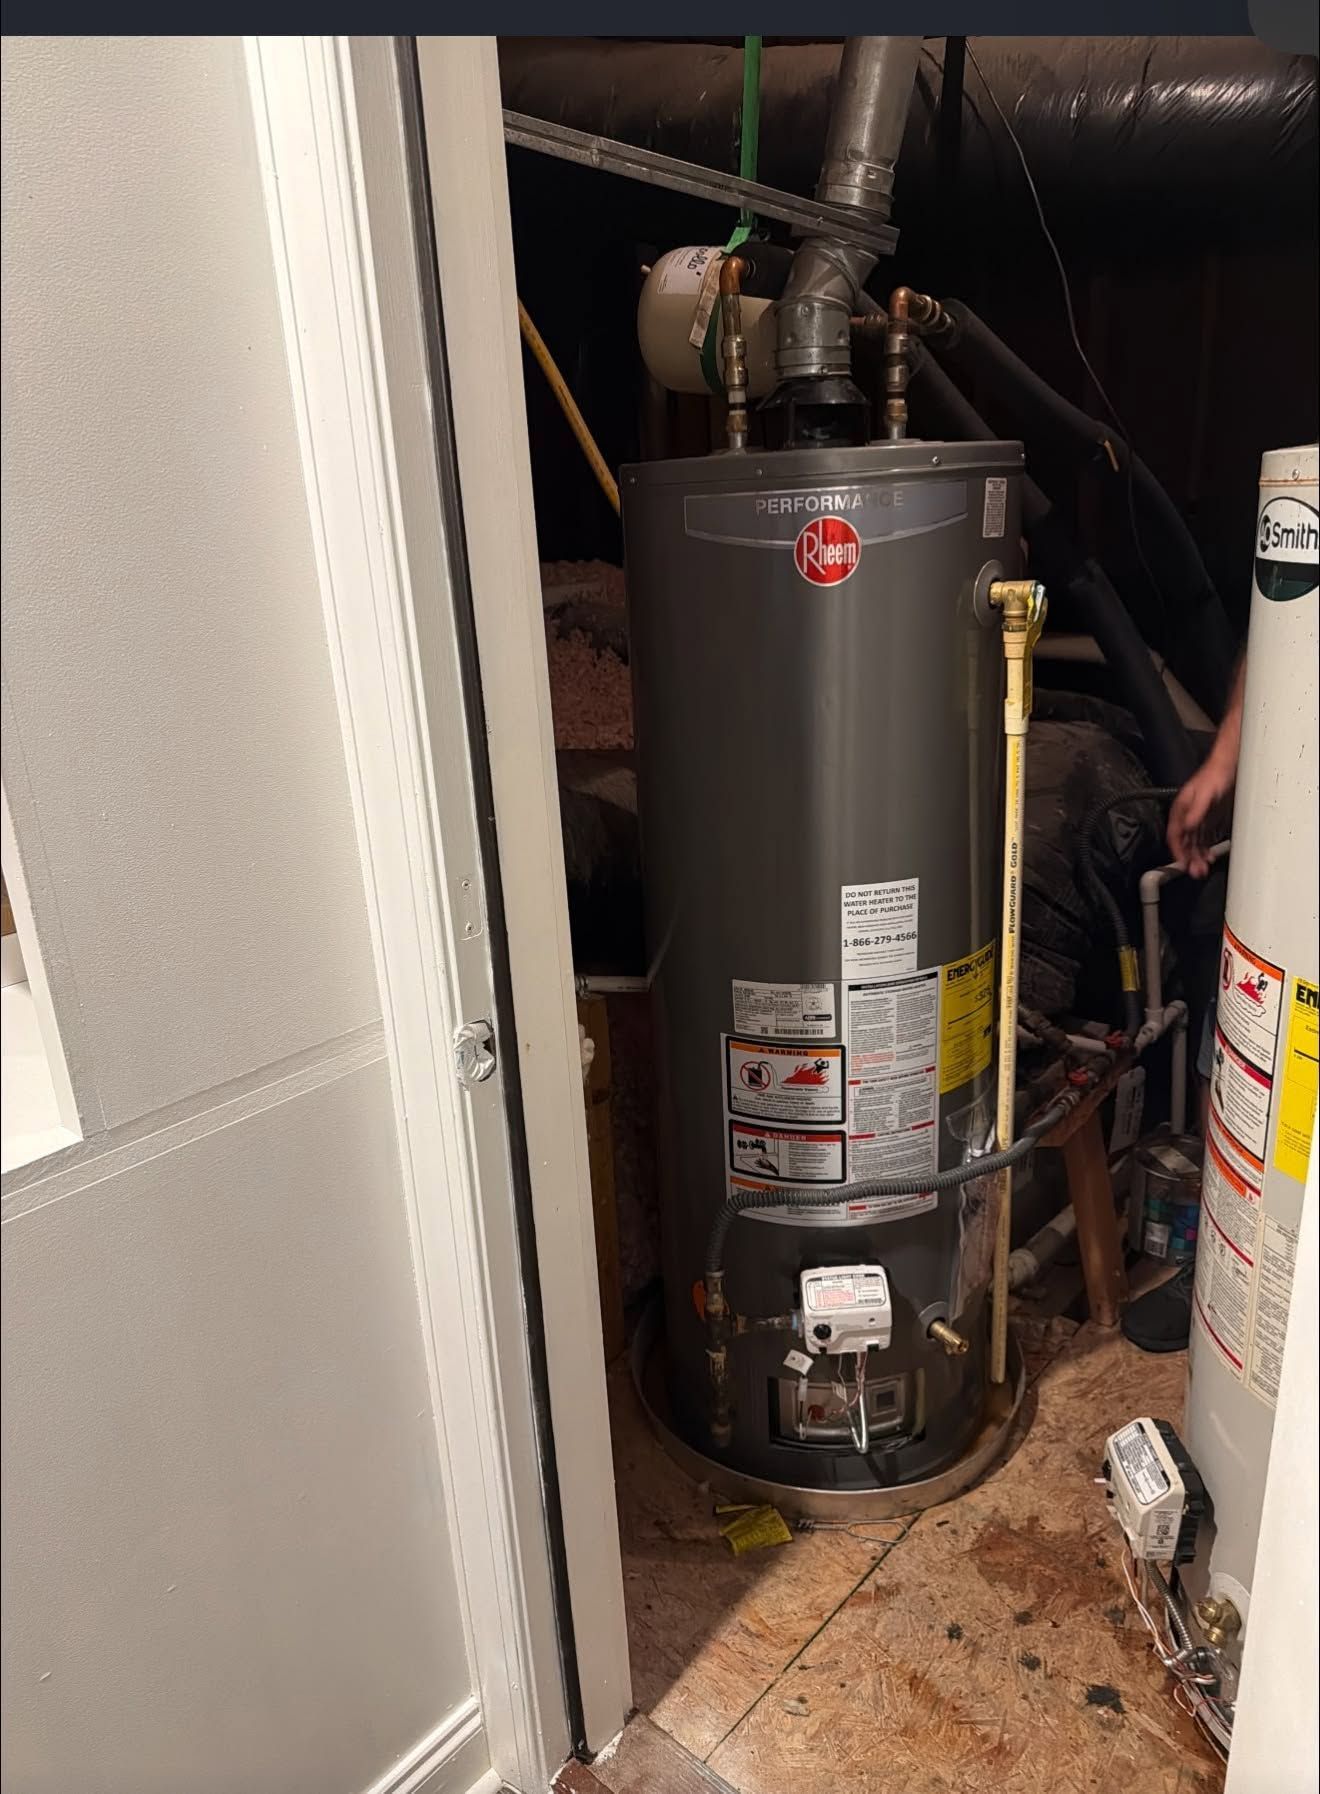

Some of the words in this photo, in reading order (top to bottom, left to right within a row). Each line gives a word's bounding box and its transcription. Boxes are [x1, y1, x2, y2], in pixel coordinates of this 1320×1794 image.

[755, 491, 904, 515] PERFORMACE
[803, 520, 857, 575] Rheem
[1271, 521, 1319, 550] Smith
[1010, 842, 1018, 869] GOLD
[858, 890, 873, 898] NOT
[874, 887, 900, 896] RETURN
[868, 897, 894, 906] HEATER
[904, 893, 917, 901] THE
[1008, 875, 1017, 934] FLOWGUARD
[880, 903, 914, 913] PURCHASE
[843, 931, 917, 948] 1-866-279-4566
